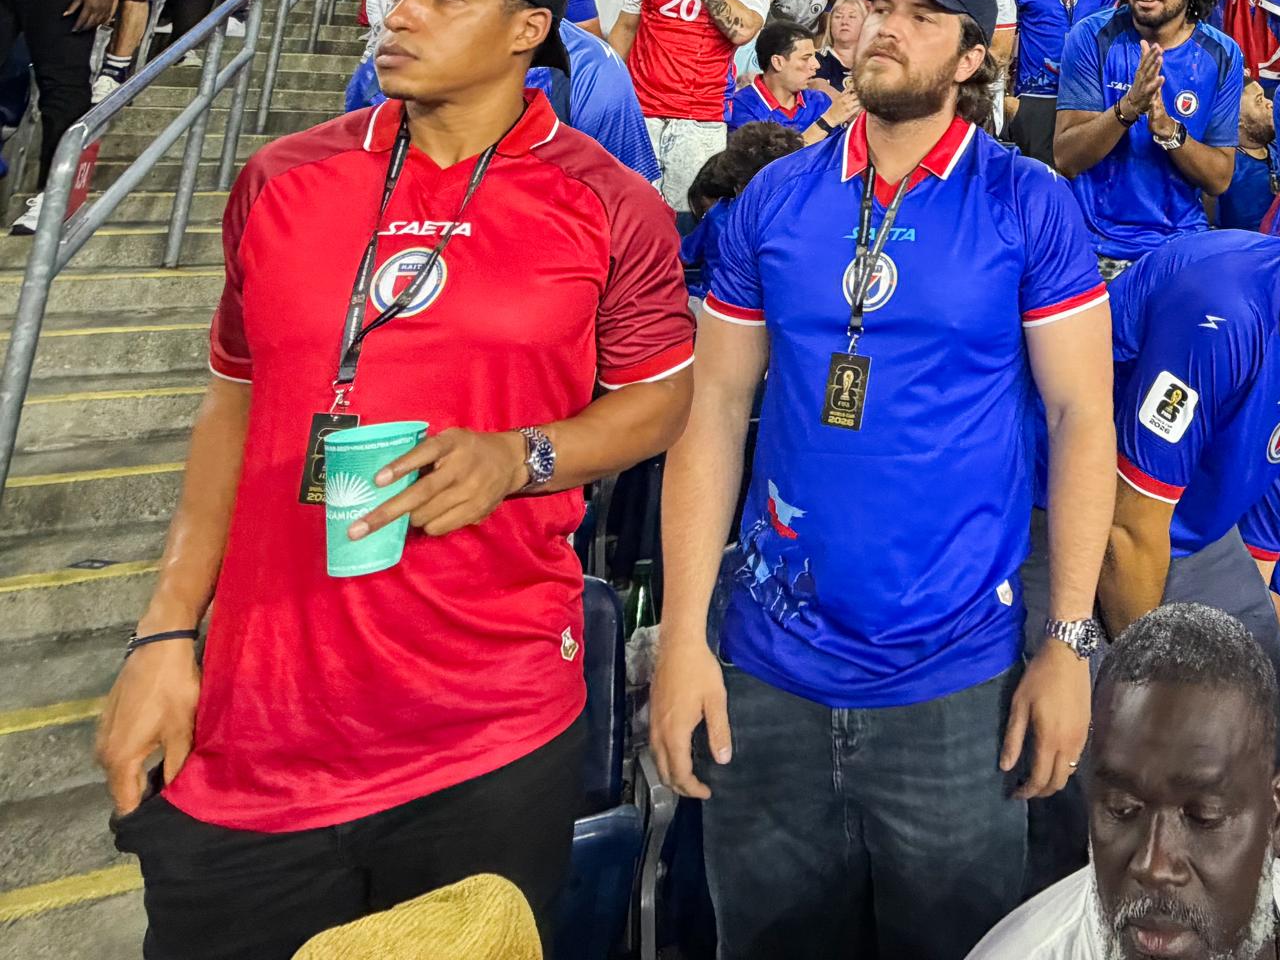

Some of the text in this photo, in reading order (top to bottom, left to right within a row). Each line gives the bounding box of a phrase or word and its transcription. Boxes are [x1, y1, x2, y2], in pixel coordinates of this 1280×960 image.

[376, 221, 472, 237] SAETA
[841, 226, 917, 241] SATA
[306, 491, 326, 502] 20
